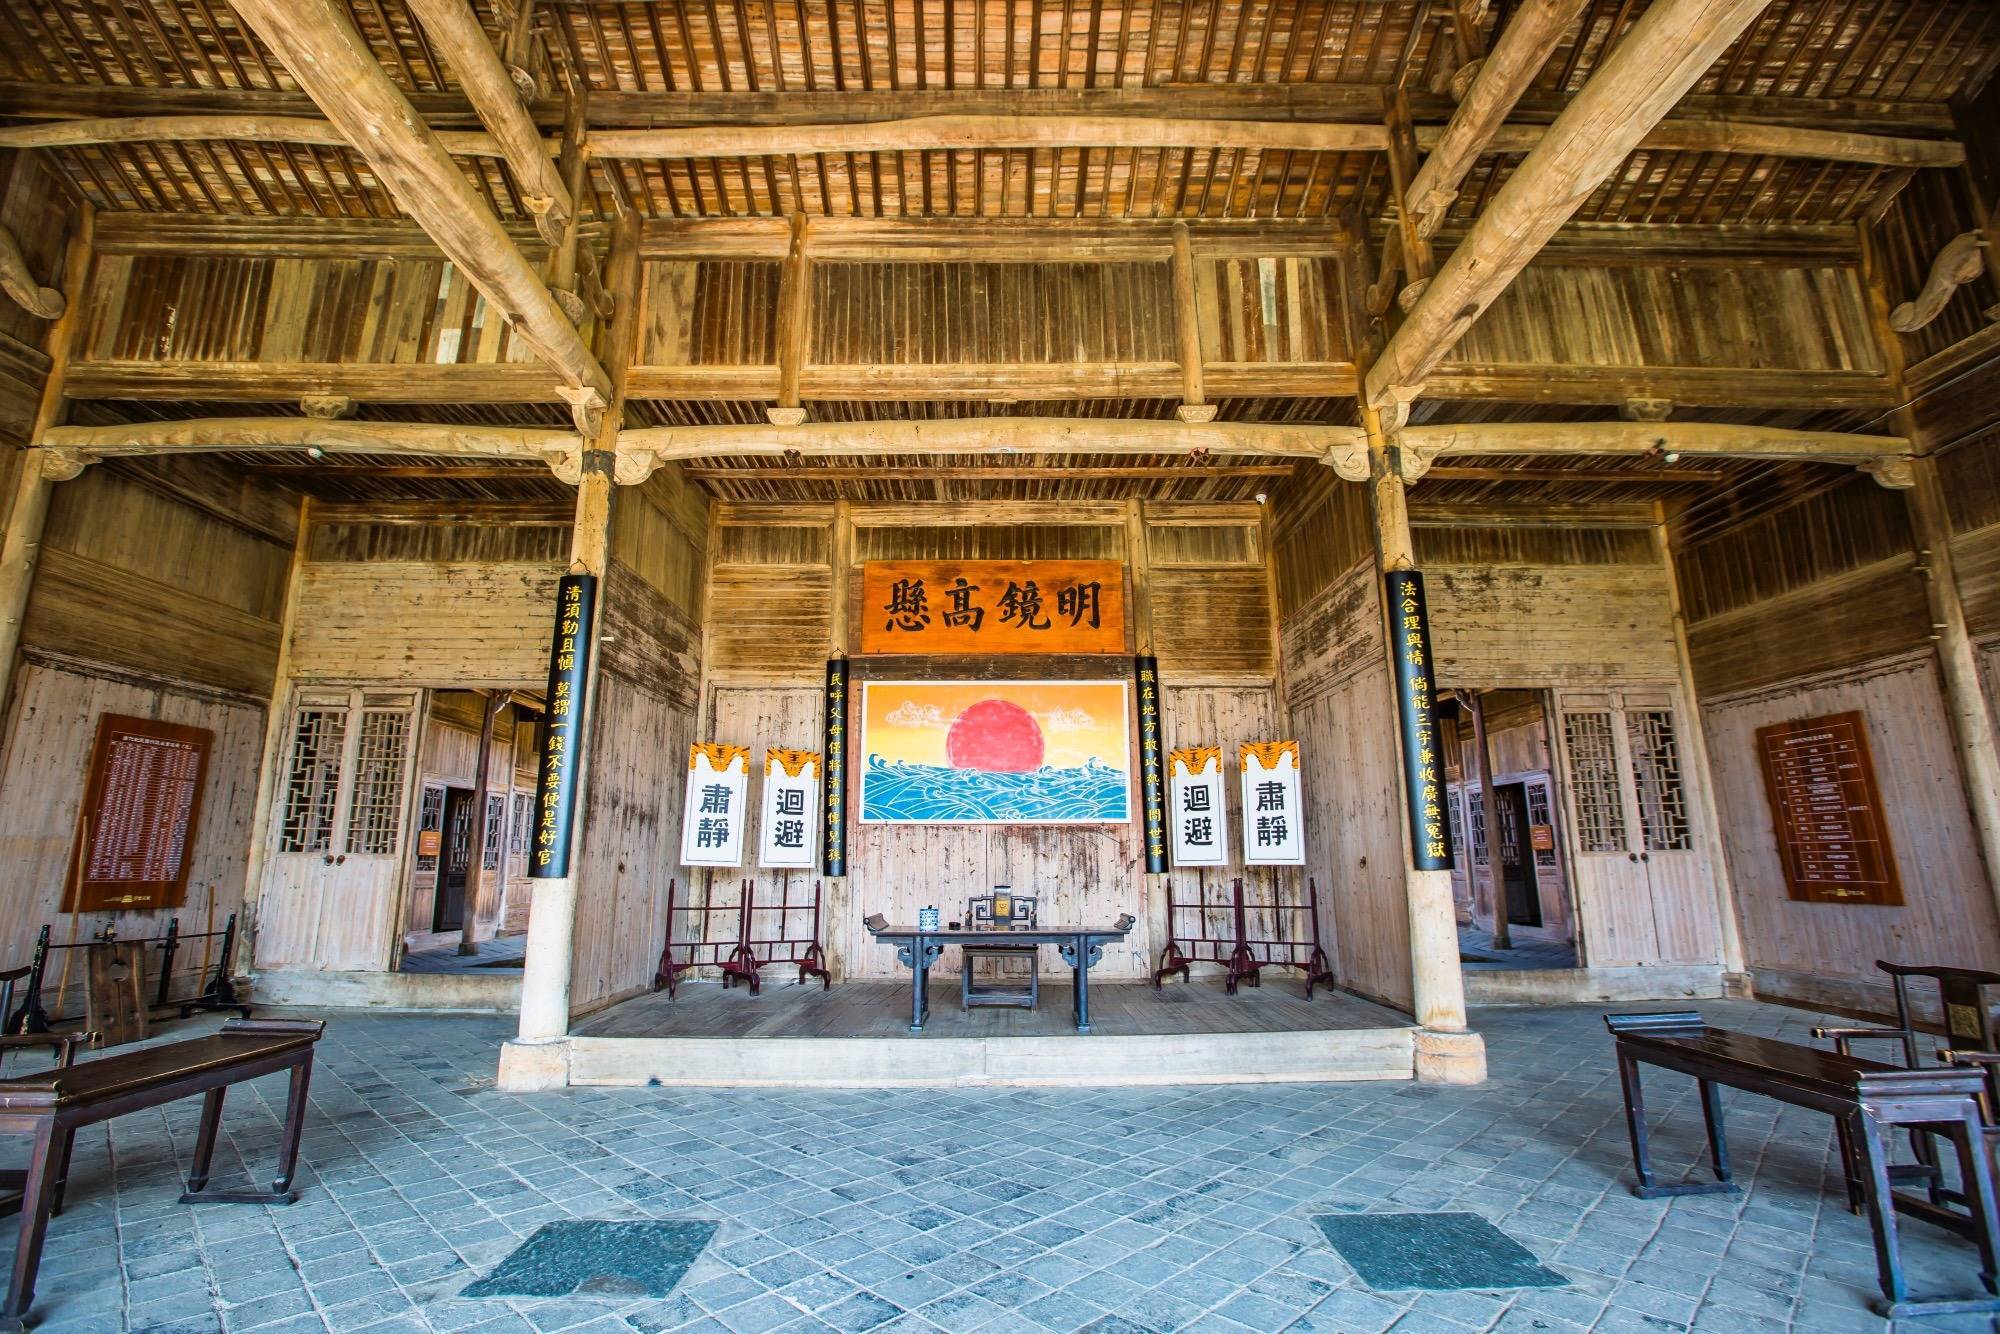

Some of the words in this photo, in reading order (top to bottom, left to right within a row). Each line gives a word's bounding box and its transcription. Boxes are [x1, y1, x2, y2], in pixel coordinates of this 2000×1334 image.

[697, 783, 733, 848] 肅靜
[774, 787, 805, 849] 迴避
[1183, 784, 1214, 846] 迴避
[1255, 781, 1288, 847] 肅靜
